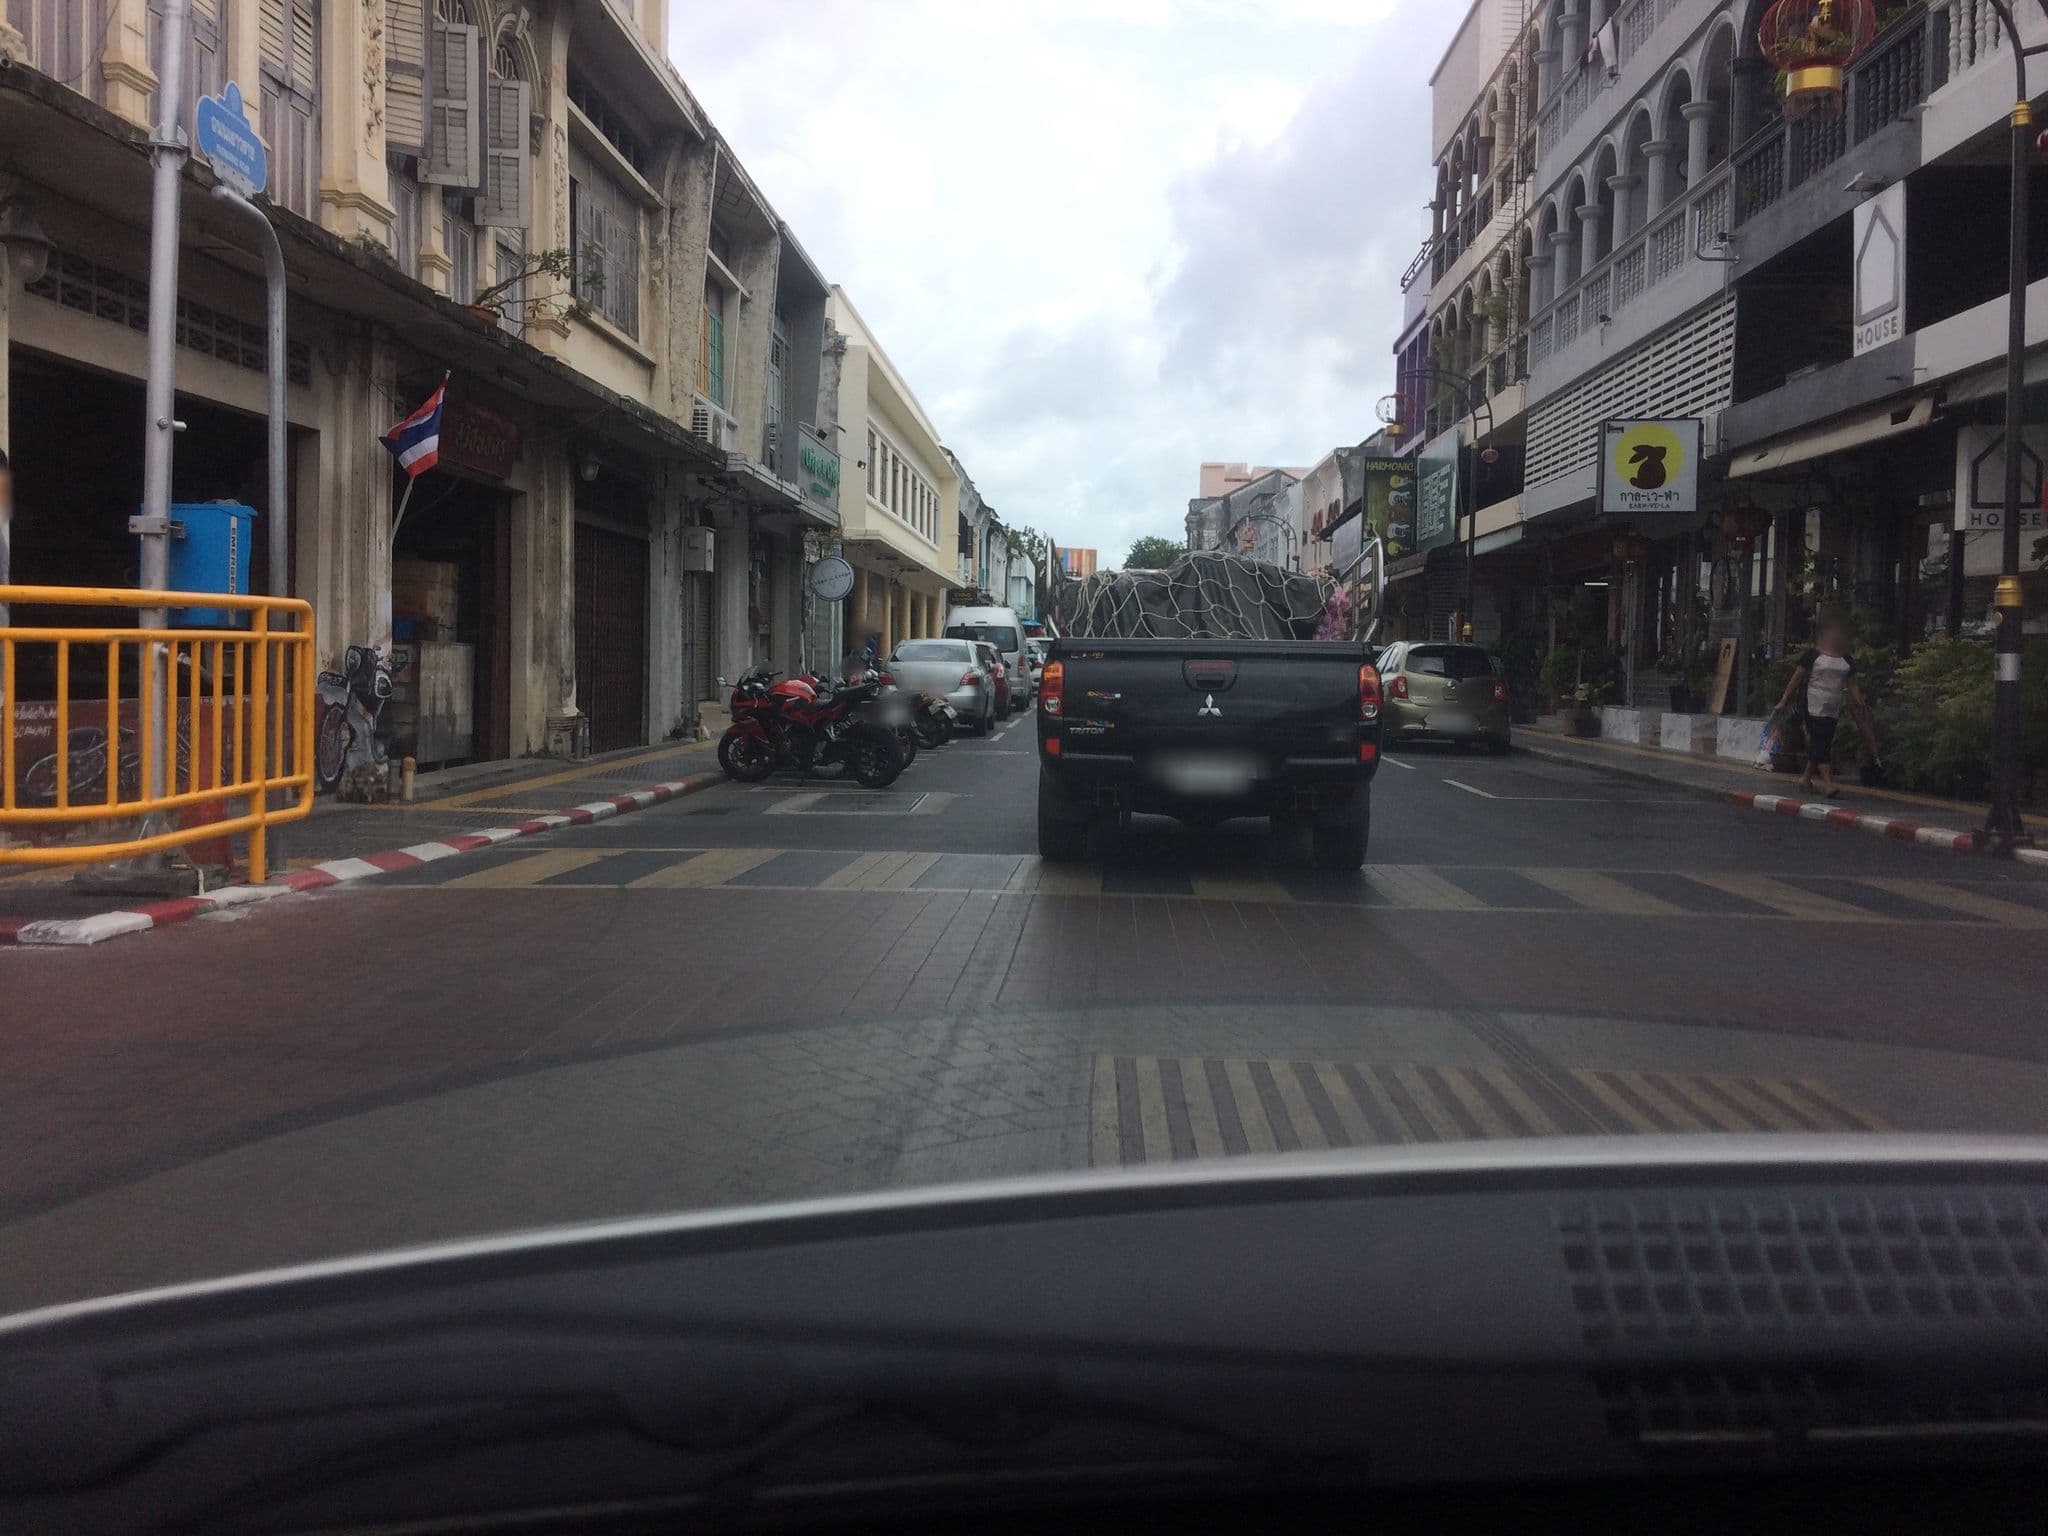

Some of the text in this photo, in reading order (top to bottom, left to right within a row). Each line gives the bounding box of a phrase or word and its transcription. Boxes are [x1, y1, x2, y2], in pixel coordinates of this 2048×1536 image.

[1856, 315, 1898, 350] HOUSE
[1366, 461, 1414, 472] HARMONIC
[1971, 512, 2041, 526] HOSE
[1069, 727, 1105, 736] TRITON
